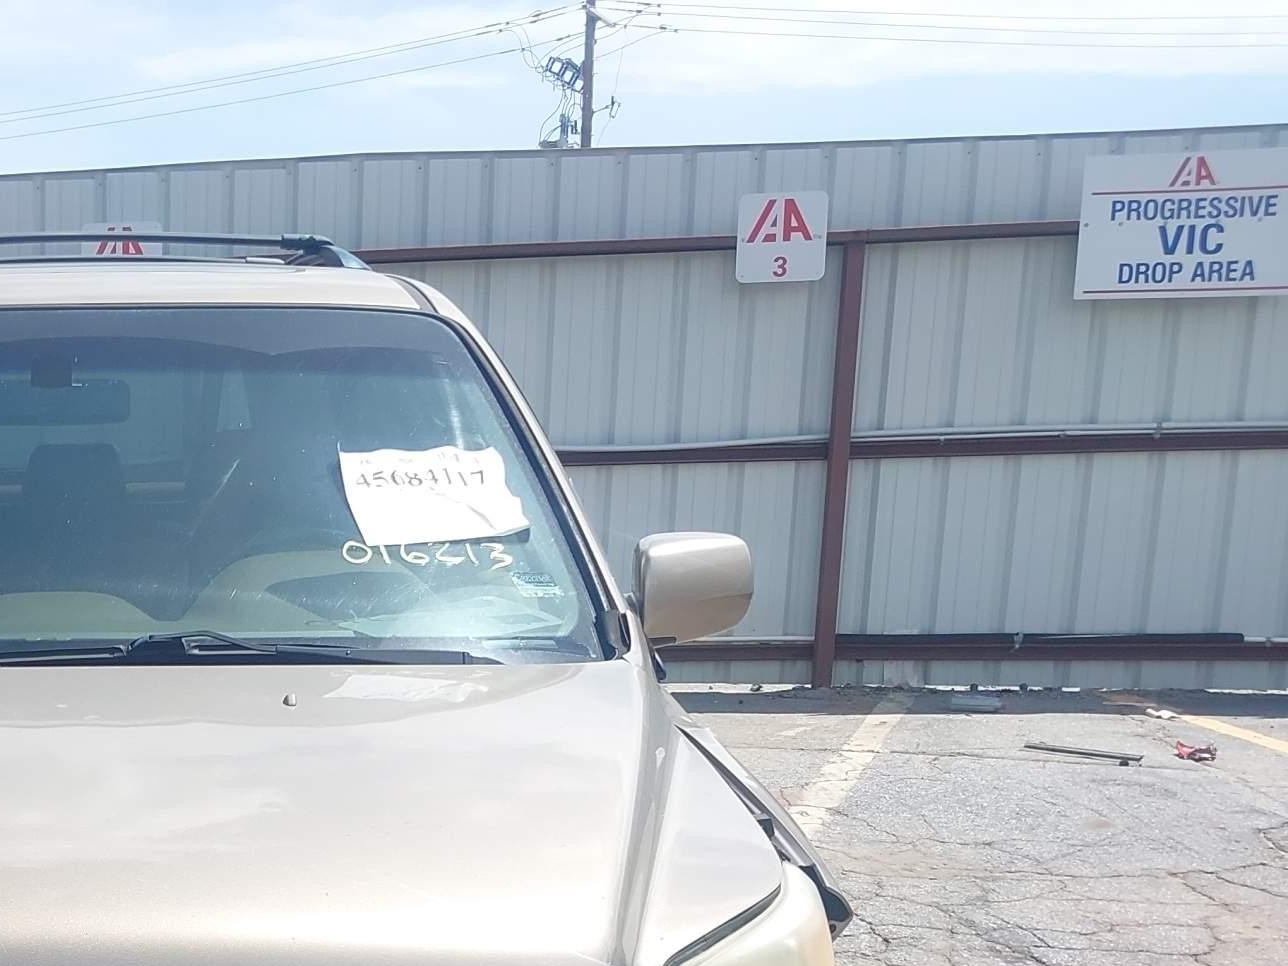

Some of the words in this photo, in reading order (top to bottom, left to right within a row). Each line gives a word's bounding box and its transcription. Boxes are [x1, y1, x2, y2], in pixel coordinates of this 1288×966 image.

[1110, 194, 1279, 221] PROGRESSIVE
[1158, 222, 1225, 256] VIC
[772, 256, 788, 277] 3
[1117, 262, 1183, 284] DROP
[1190, 260, 1255, 283] AREA
[355, 467, 485, 488] 45684117
